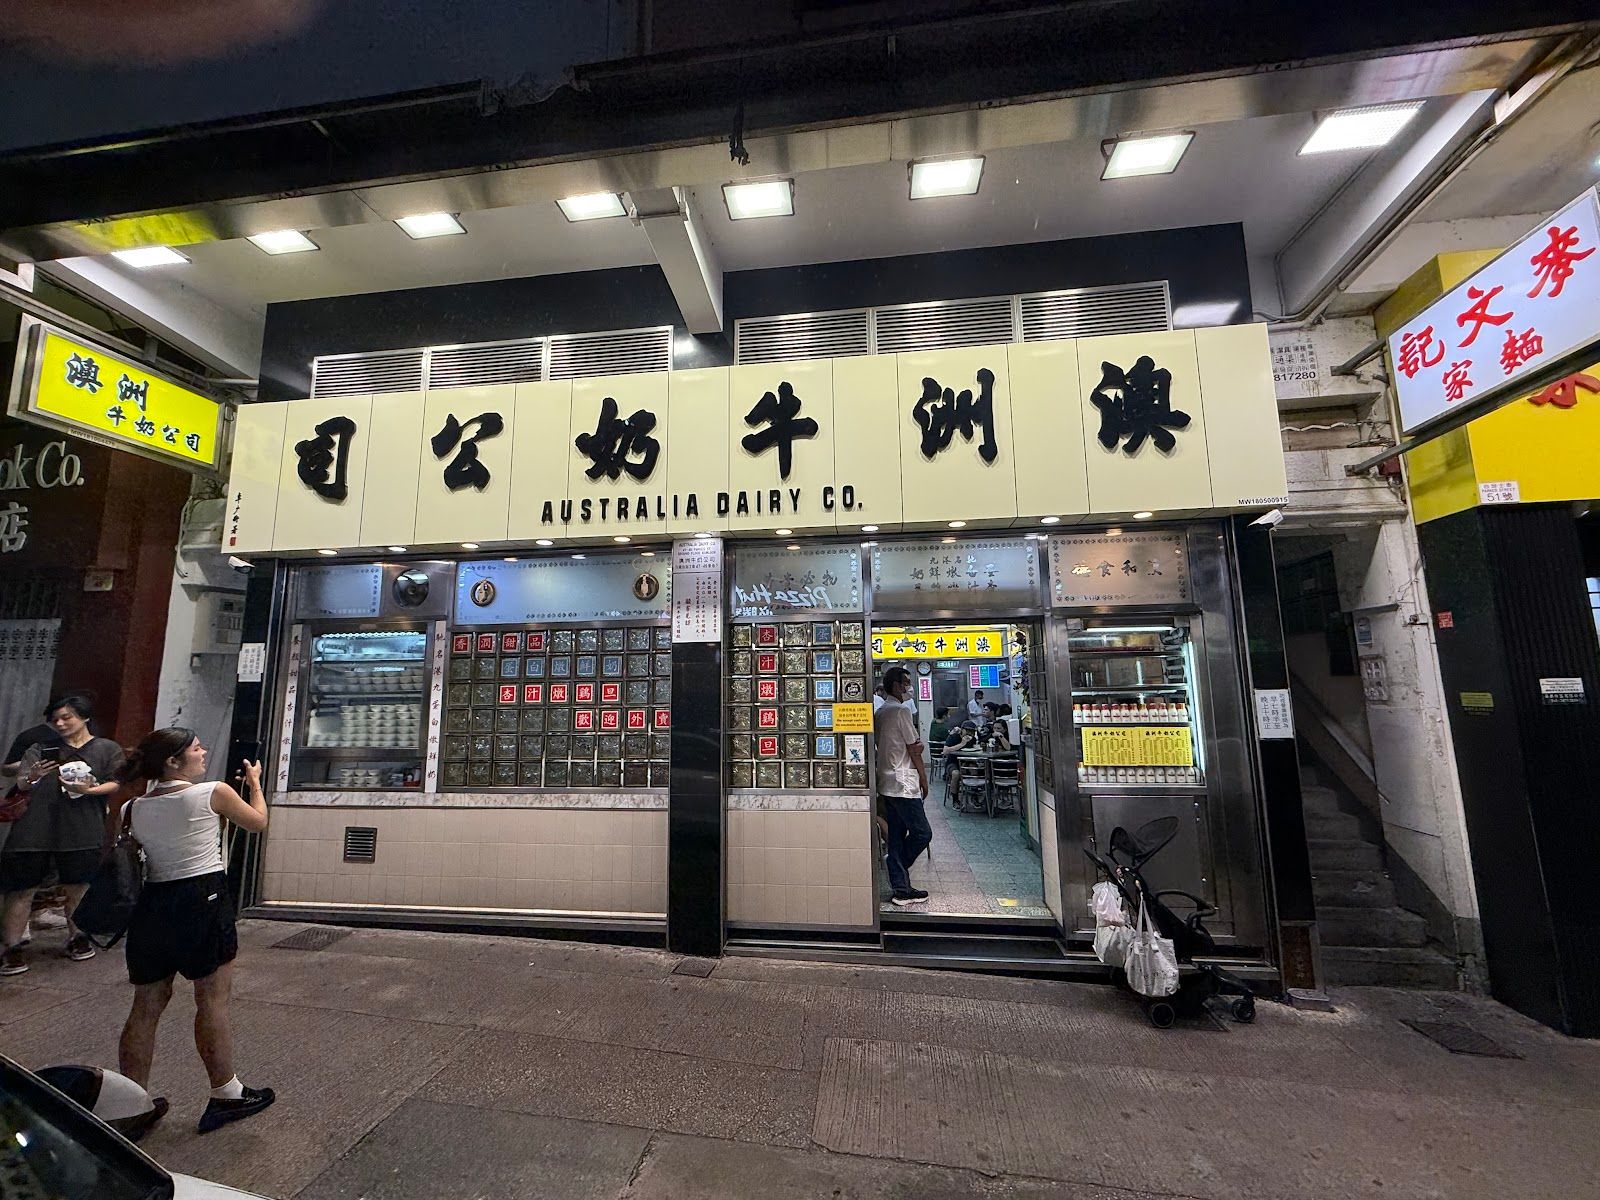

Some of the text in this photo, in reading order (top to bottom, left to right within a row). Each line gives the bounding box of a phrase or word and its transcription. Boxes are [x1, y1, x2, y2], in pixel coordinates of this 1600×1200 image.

[66, 352, 149, 411] 澳洲
[106, 405, 201, 452] 牛奶公司
[294, 354, 1191, 501] 澳洲牛奶公司
[36, 441, 85, 488] Co.
[0, 501, 28, 553] 店
[541, 485, 864, 524] AUSTRALIA DAIRY CO.
